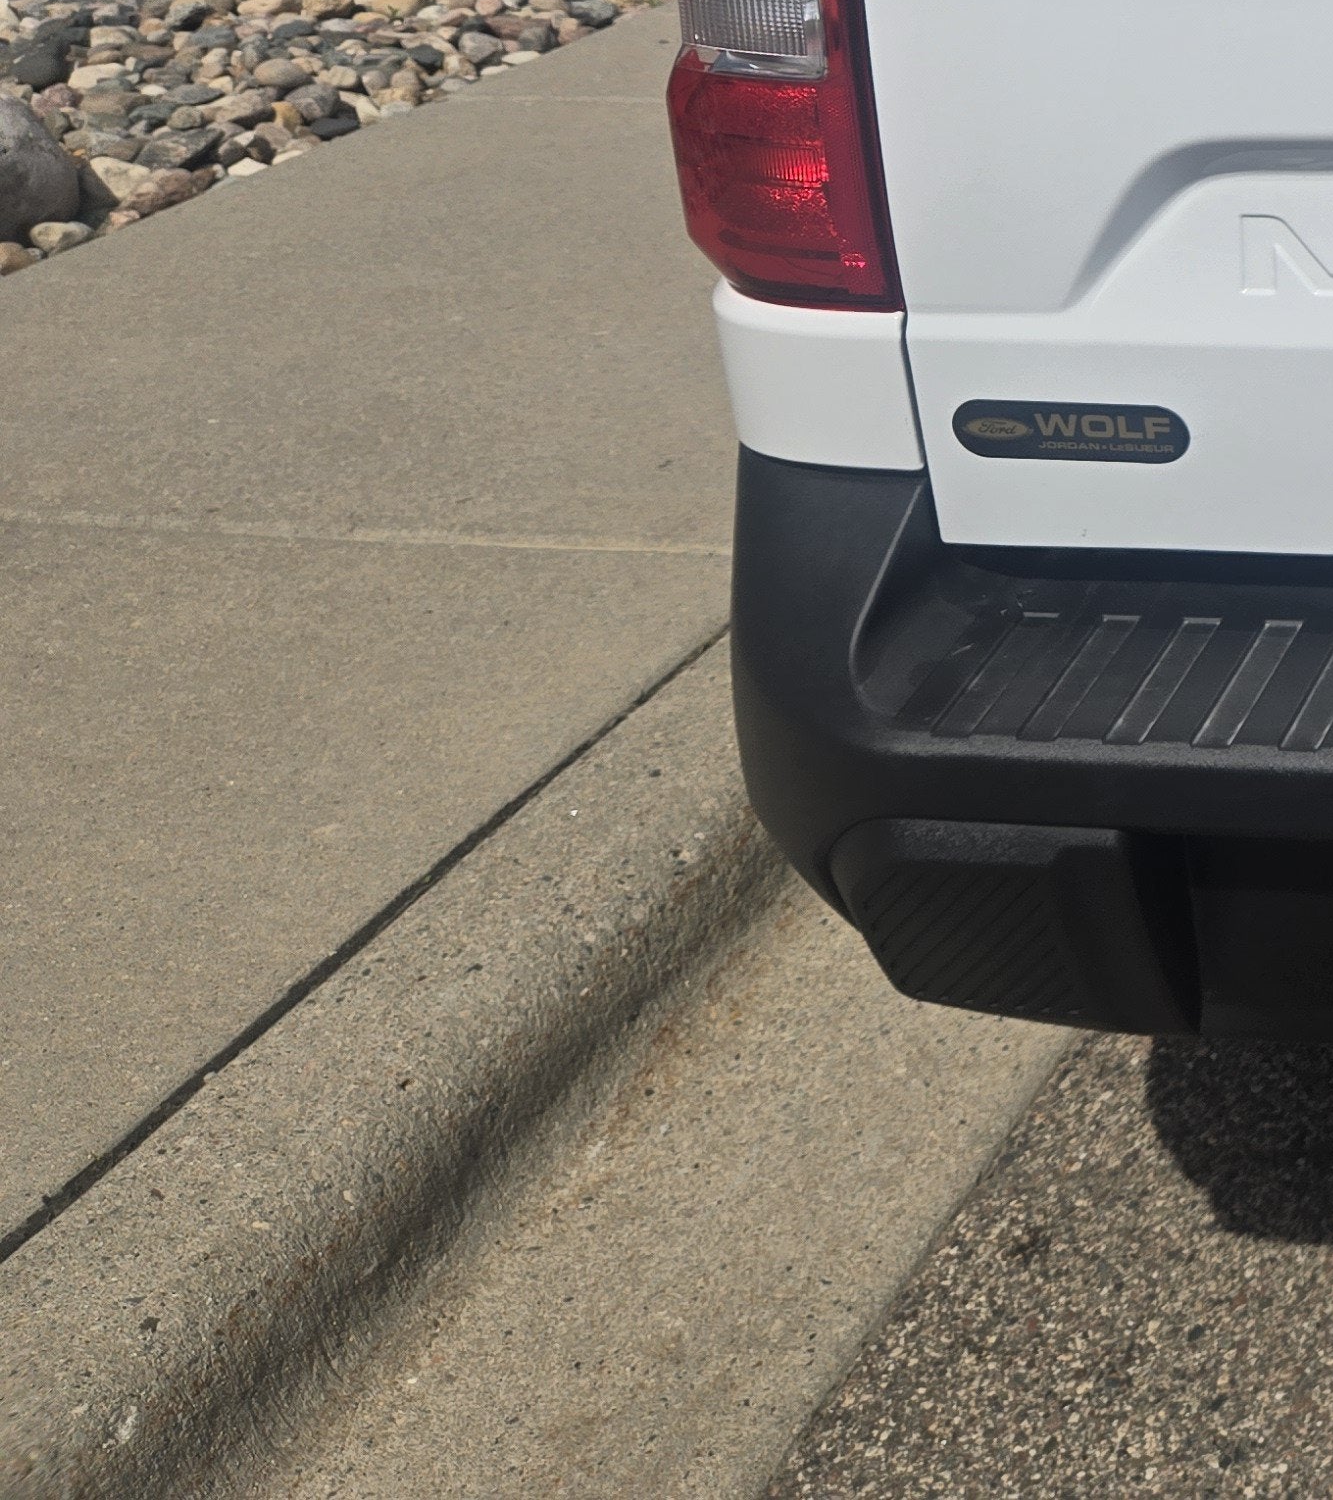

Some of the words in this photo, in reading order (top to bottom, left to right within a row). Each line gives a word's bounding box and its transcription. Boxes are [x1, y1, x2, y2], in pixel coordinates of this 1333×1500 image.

[977, 420, 1018, 435] Ford
[1034, 413, 1171, 439] WOLF
[1038, 440, 1100, 451] JORDAN
